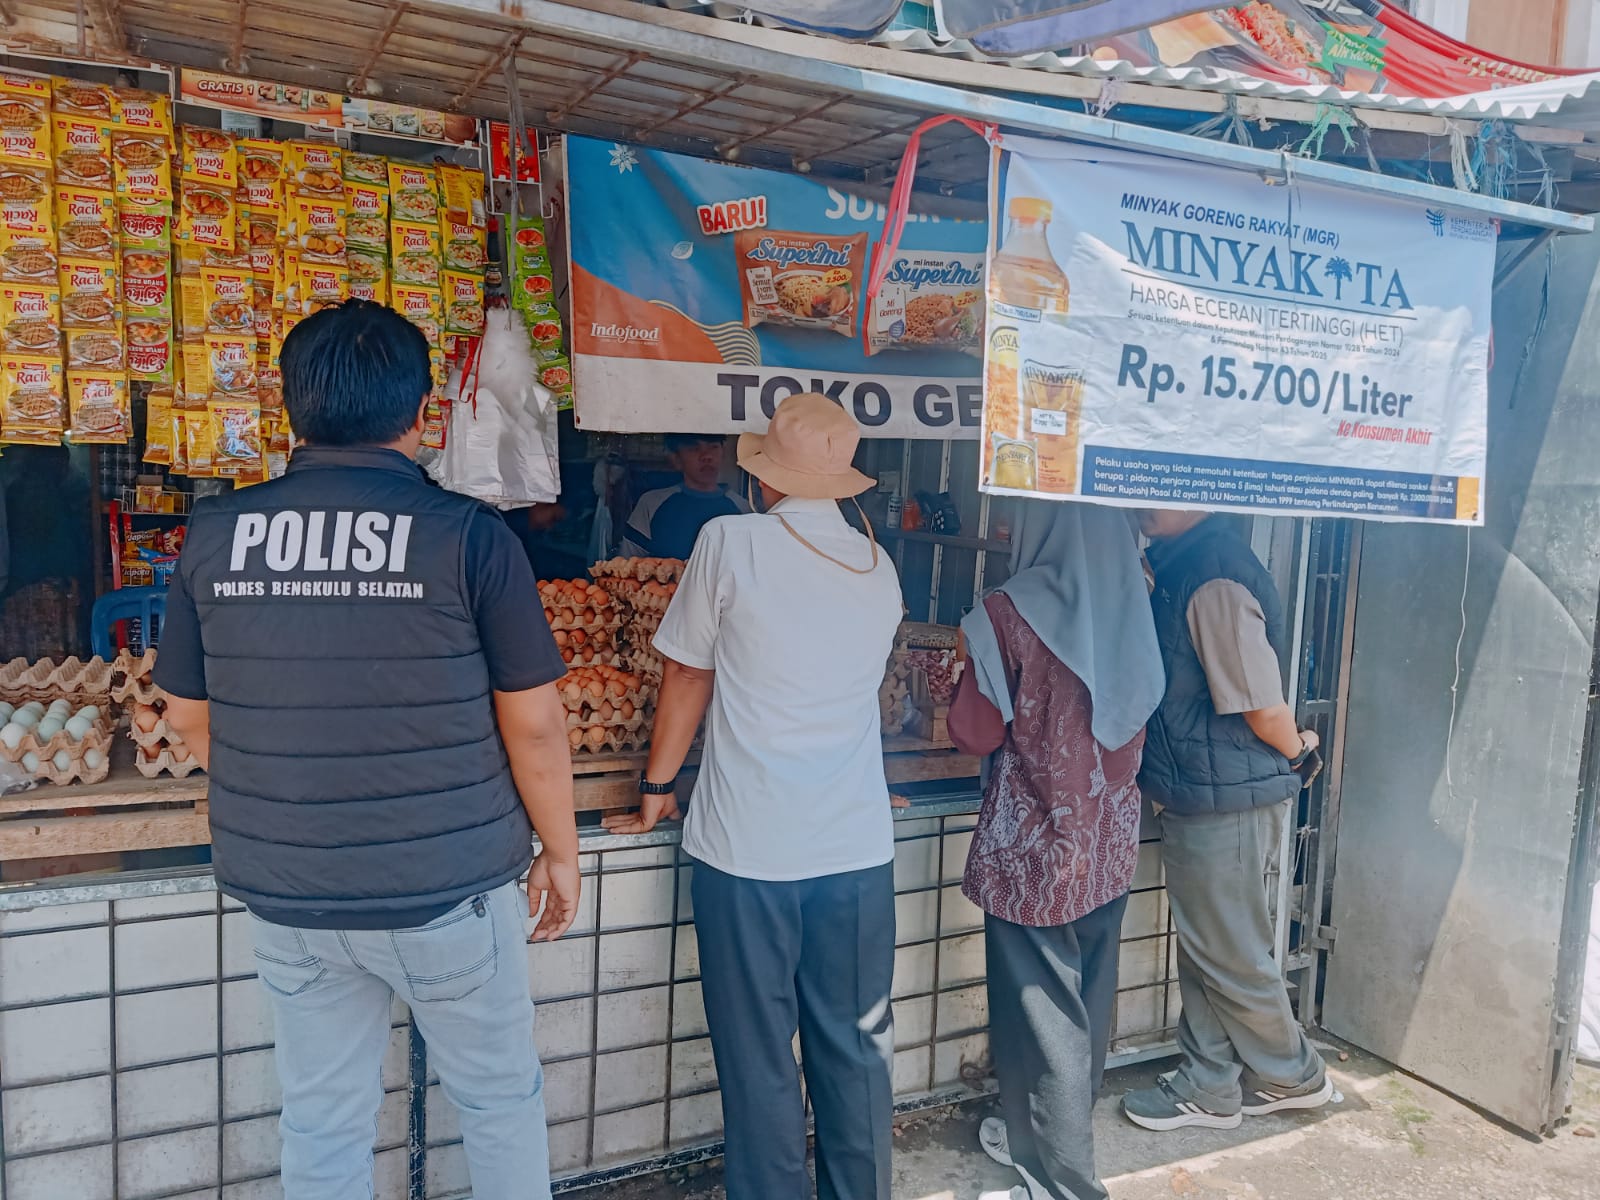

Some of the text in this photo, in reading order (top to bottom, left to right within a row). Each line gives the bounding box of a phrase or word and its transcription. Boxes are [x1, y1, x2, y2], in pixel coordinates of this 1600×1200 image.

[198, 80, 255, 96] GRATIS 1
[121, 108, 153, 119] Racik
[0, 136, 36, 149] Racik
[67, 132, 101, 145] Racik
[194, 158, 224, 170] Racik
[304, 153, 333, 165] Racik
[126, 174, 159, 187] Racik
[401, 174, 427, 185] Racik
[249, 188, 273, 200] Raci
[352, 197, 380, 209] Racik
[2, 209, 38, 222] Racik
[69, 203, 103, 217] Racik
[699, 198, 765, 234] BARU!
[308, 213, 337, 225] Racik
[1121, 193, 1340, 250] MINYAK GORENG RAKYAT (MGR)
[192, 225, 222, 237] Racik
[403, 235, 430, 247] Racik
[925, 260, 944, 268] instan
[71, 273, 104, 287] Racik
[310, 279, 339, 291] Racik
[215, 283, 245, 296] Racik
[454, 286, 477, 296] Racik
[14, 299, 49, 313] Racik
[404, 299, 431, 310] Racik
[1130, 283, 1404, 350] HARGA ECERAN TERTINGGI (HET)
[591, 322, 660, 343] Indofood
[1128, 309, 1153, 321] Sesuai
[1321, 340, 1342, 352] Nomor
[17, 371, 51, 385] Racik
[1117, 343, 1413, 418] Rp. 15.700/Liter
[1337, 419, 1433, 446] Ke Konsumen Akhir
[1095, 457, 1121, 469] Pelaku
[1123, 460, 1149, 471] usaha
[1151, 463, 1169, 475] yang
[1172, 464, 1192, 475] tidak
[1194, 467, 1231, 478] mematuhi
[1271, 472, 1293, 484] harga
[1365, 478, 1386, 491] dapat
[1095, 470, 1123, 483] berupa
[1130, 473, 1159, 485] pidana
[1160, 475, 1190, 488] penjara
[1192, 477, 1216, 491] paling
[1218, 479, 1236, 490] lama
[1264, 482, 1286, 493] tahun
[1304, 485, 1328, 498] pidana
[1329, 486, 1352, 497] denda
[1353, 488, 1374, 501] paling
[1094, 482, 1117, 493] Miliar
[1150, 486, 1171, 497] Pasal
[1183, 490, 1199, 502] ayat
[1210, 491, 1222, 501] UU
[1224, 493, 1248, 504] Nomor
[1256, 494, 1277, 505] Tahun
[1279, 496, 1293, 506] 1999
[229, 510, 414, 573] POLISI
[213, 581, 424, 599] POLRES BENGKULU SELATAN
